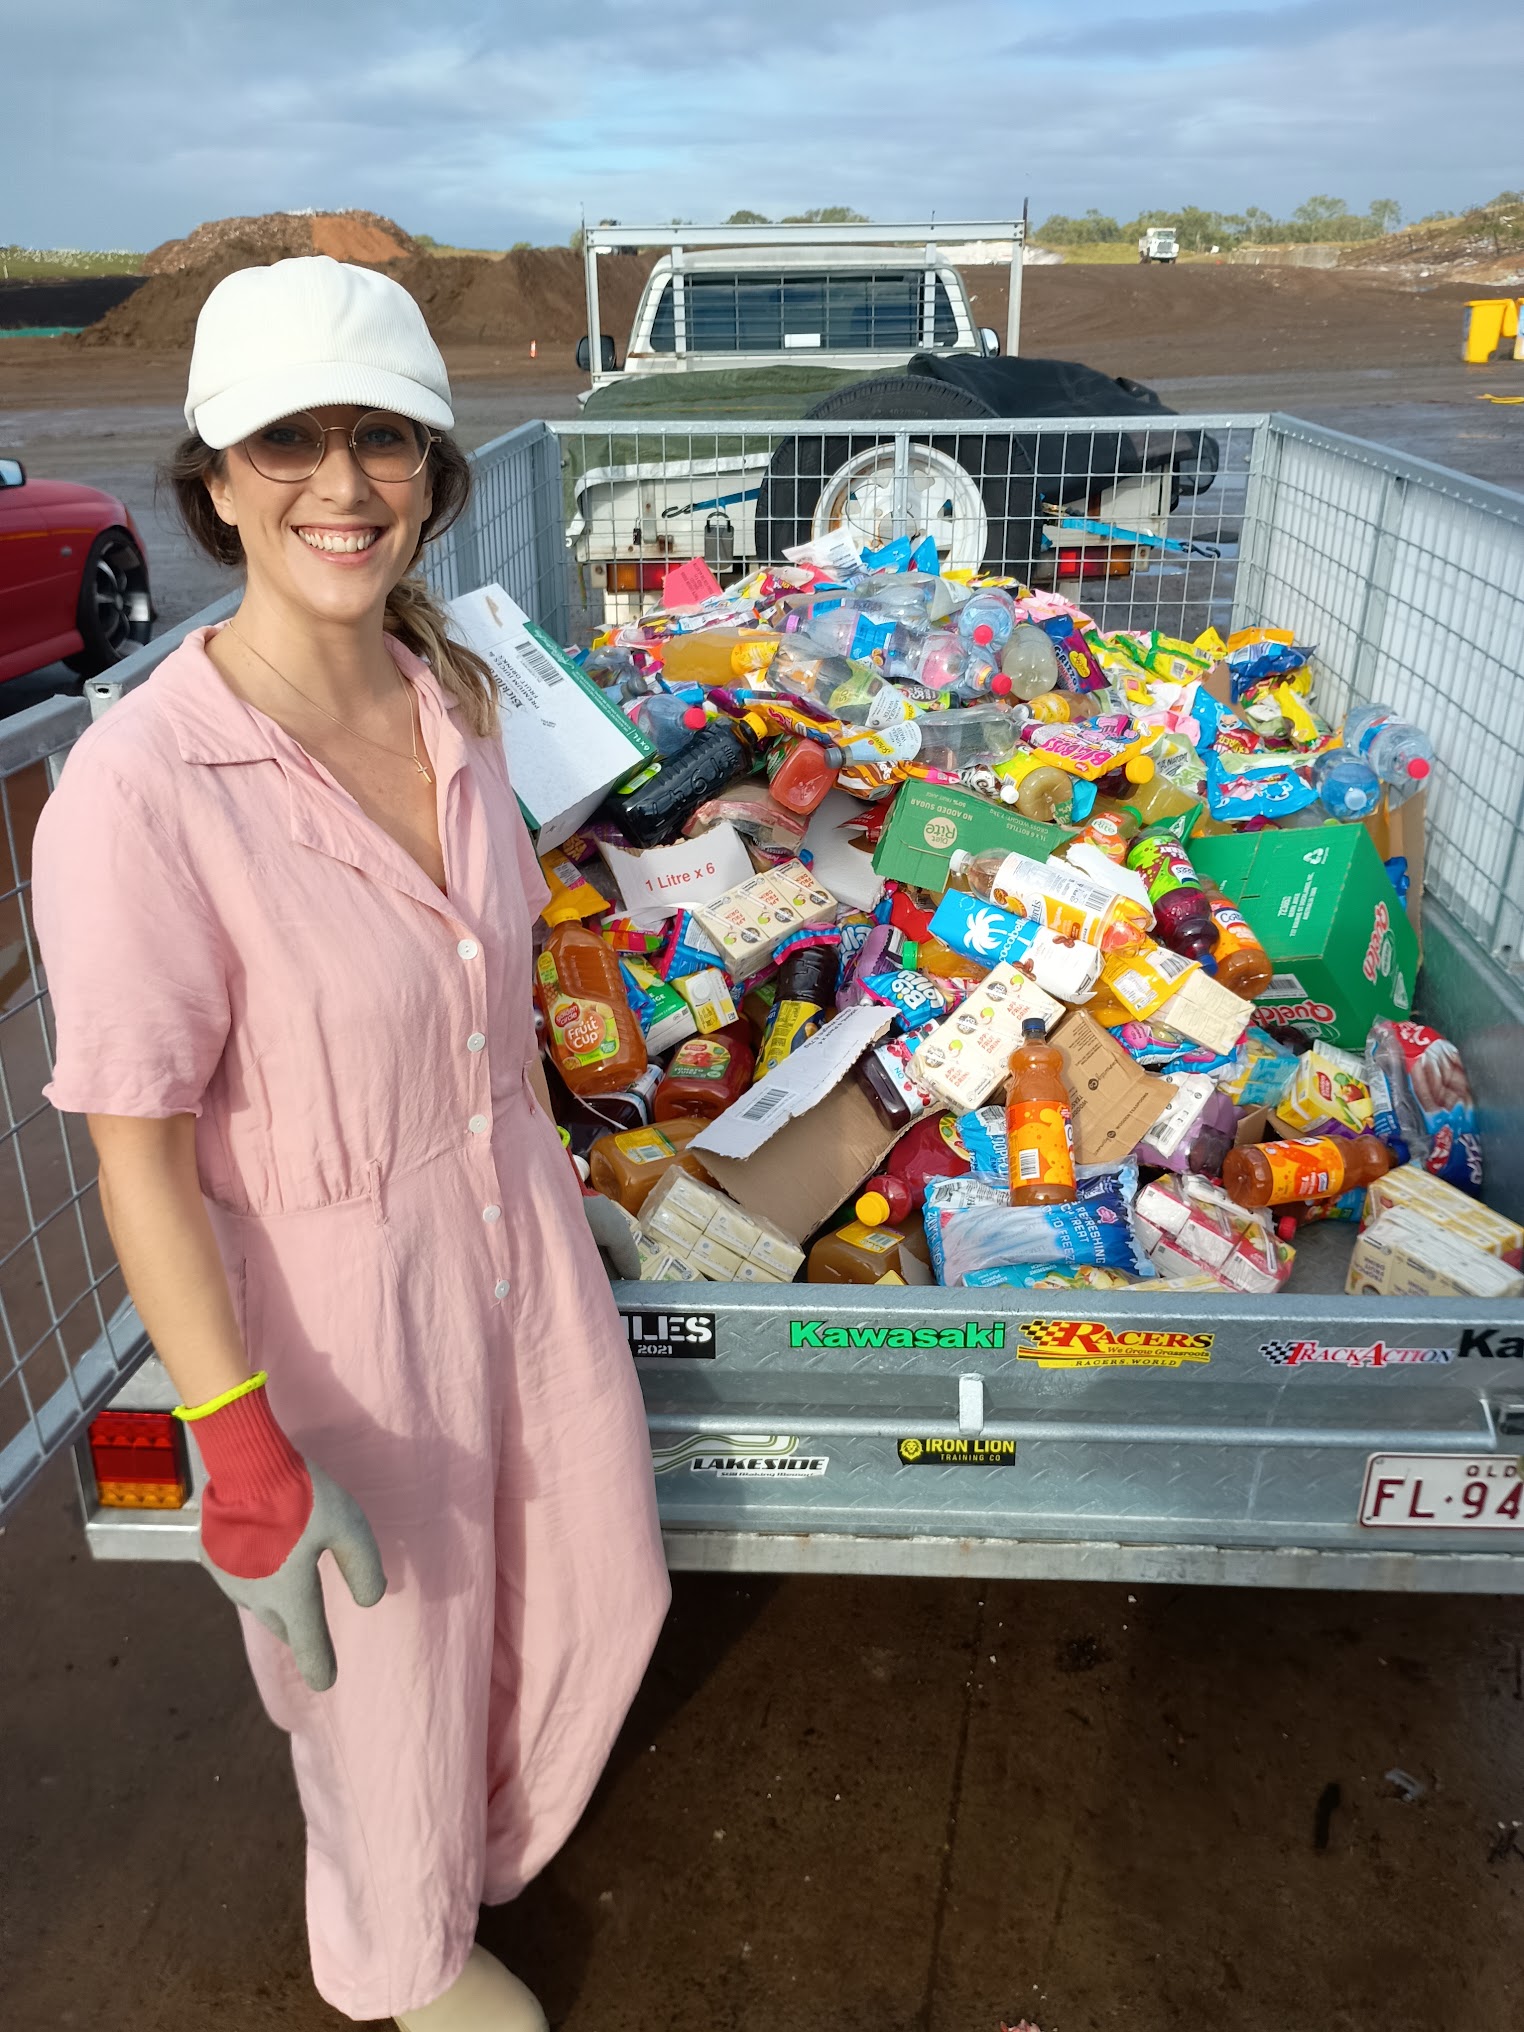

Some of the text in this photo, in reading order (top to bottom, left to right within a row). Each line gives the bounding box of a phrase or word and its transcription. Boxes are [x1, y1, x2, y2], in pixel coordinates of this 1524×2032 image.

[910, 798, 974, 822] NO ADDED SUGAR
[953, 799, 967, 808] 50%
[926, 823, 956, 840] Rite
[1006, 822, 1031, 837] BOTTLES
[1030, 824, 1049, 834] GROSS
[932, 835, 948, 845] Diet
[646, 862, 715, 891] 1 Litre x 6
[1253, 1002, 1335, 1024] Quelch
[568, 1016, 599, 1040] Fruit
[573, 1032, 598, 1049] Cup
[1070, 1216, 1090, 1243] TREAT
[1076, 1206, 1106, 1264] REFRESHING
[1060, 1229, 1075, 1264] FREEZE
[790, 1320, 1006, 1349] Kawasaki
[1048, 1320, 1214, 1354] RACERS
[637, 1344, 673, 1355] 2021
[1125, 1347, 1153, 1355] Grow
[1155, 1348, 1211, 1358] Grassroots
[926, 1440, 1016, 1454] IRON LION
[693, 1458, 826, 1470] LAKESIDE
[940, 1454, 1002, 1462] TRAINING CO
